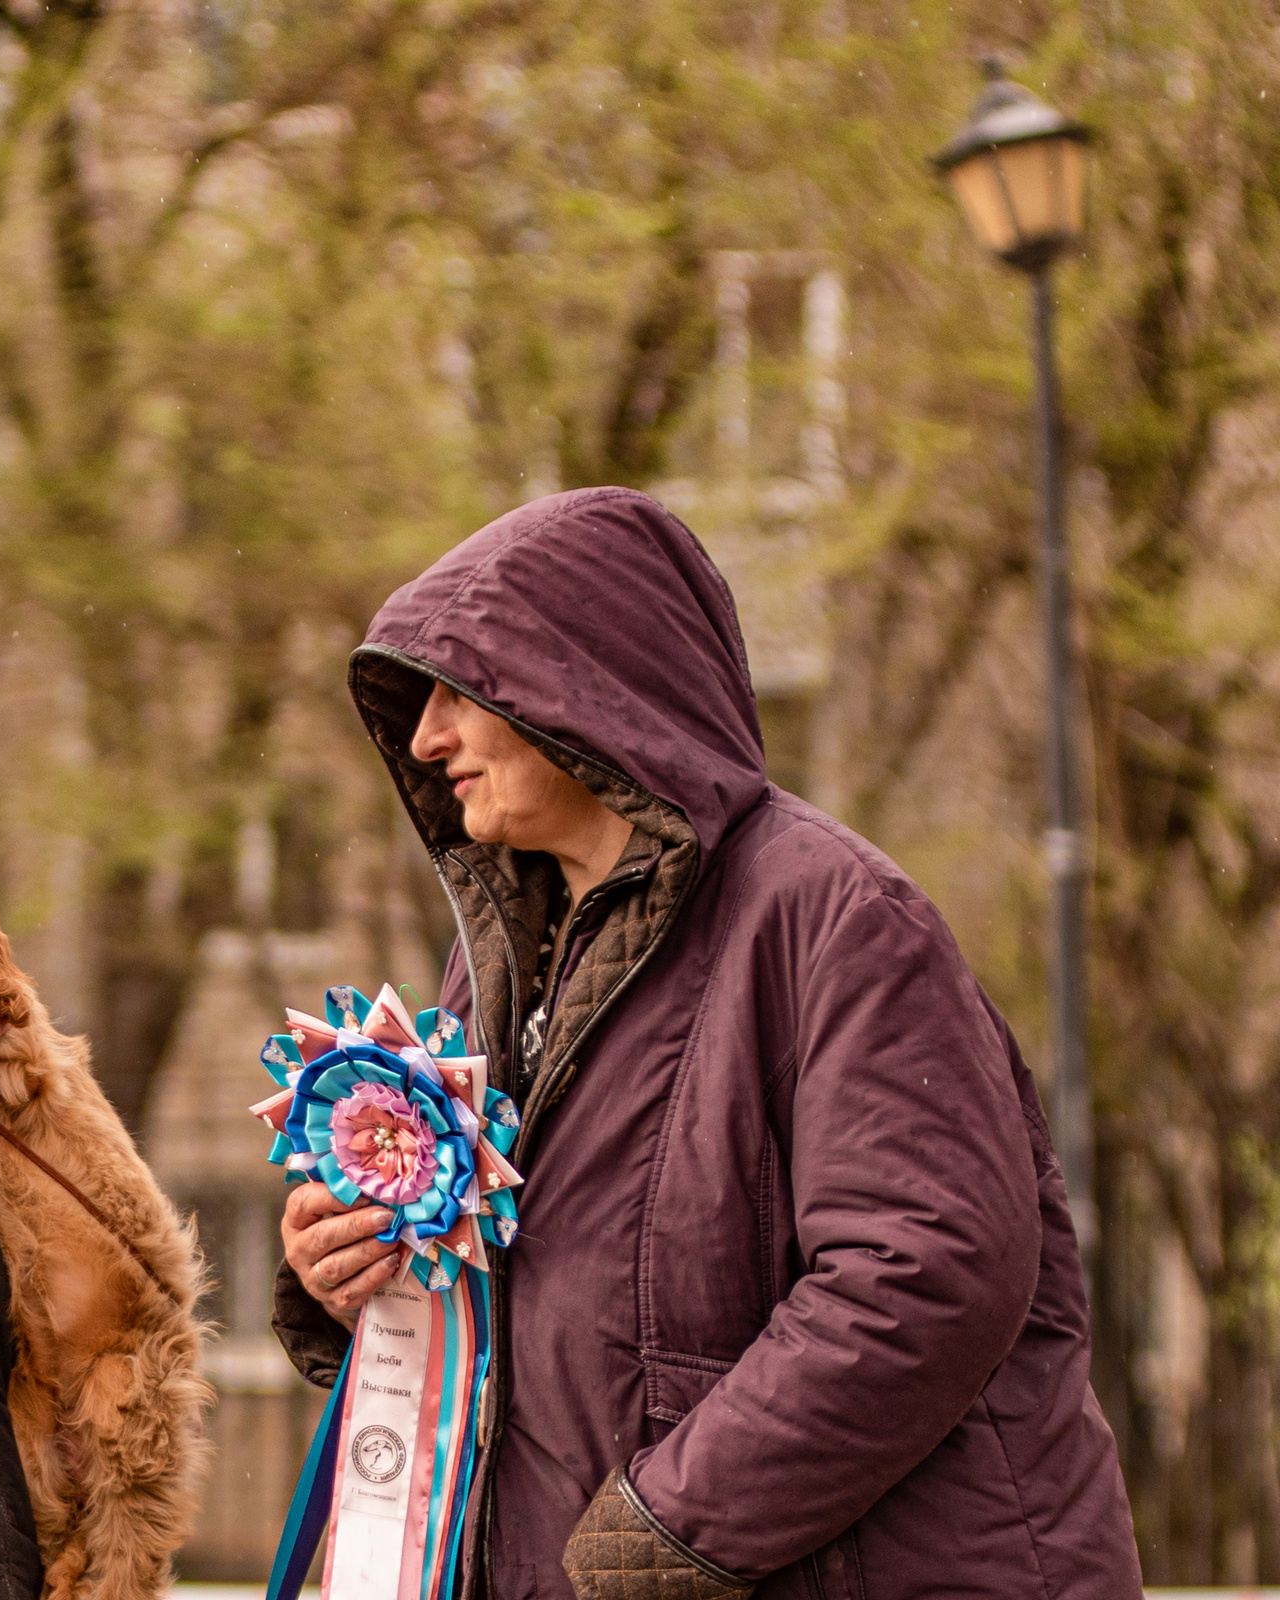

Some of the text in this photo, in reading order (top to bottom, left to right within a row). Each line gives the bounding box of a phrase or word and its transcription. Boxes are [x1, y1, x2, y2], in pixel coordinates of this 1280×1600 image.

[371, 1322, 415, 1338] Лучший
[377, 1353, 402, 1366] Беби
[361, 1379, 411, 1398] Выставки
[358, 1427, 403, 1451] КИНОЛОГИЧЕСКАЯ
[380, 1452, 404, 1481] ФЕДЕРАЦИЯ
